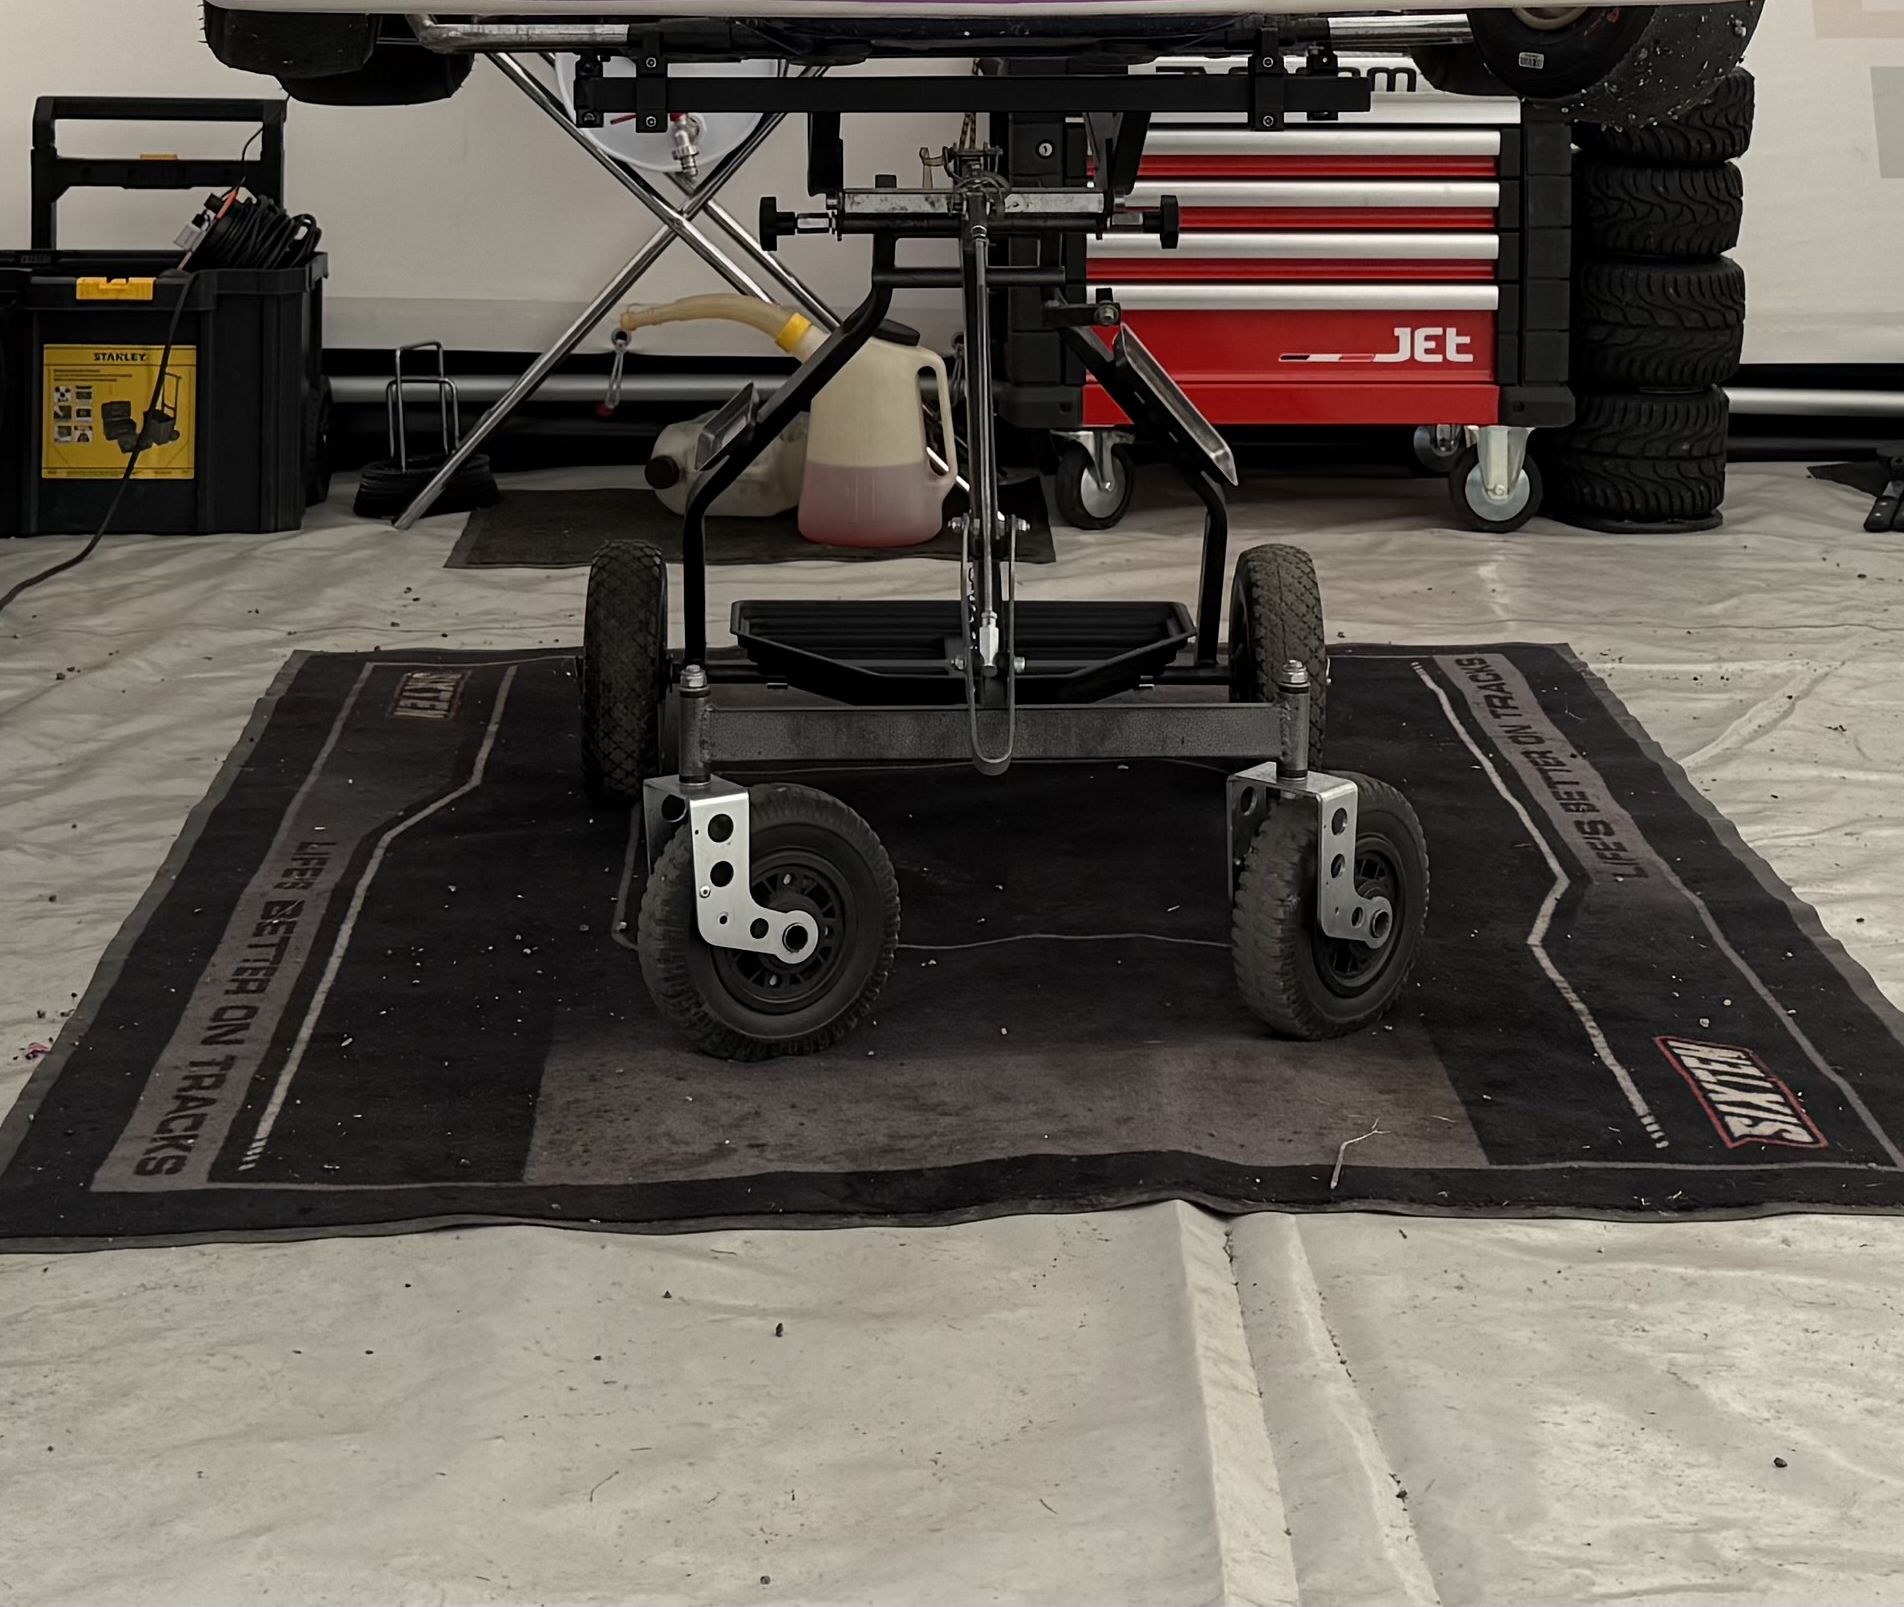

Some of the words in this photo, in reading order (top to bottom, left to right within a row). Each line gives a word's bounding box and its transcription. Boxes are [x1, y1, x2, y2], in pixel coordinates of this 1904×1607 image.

[94, 352, 146, 361] STANLEY
[201, 1003, 259, 1047] ON
[133, 1054, 236, 1178] TRACKS
